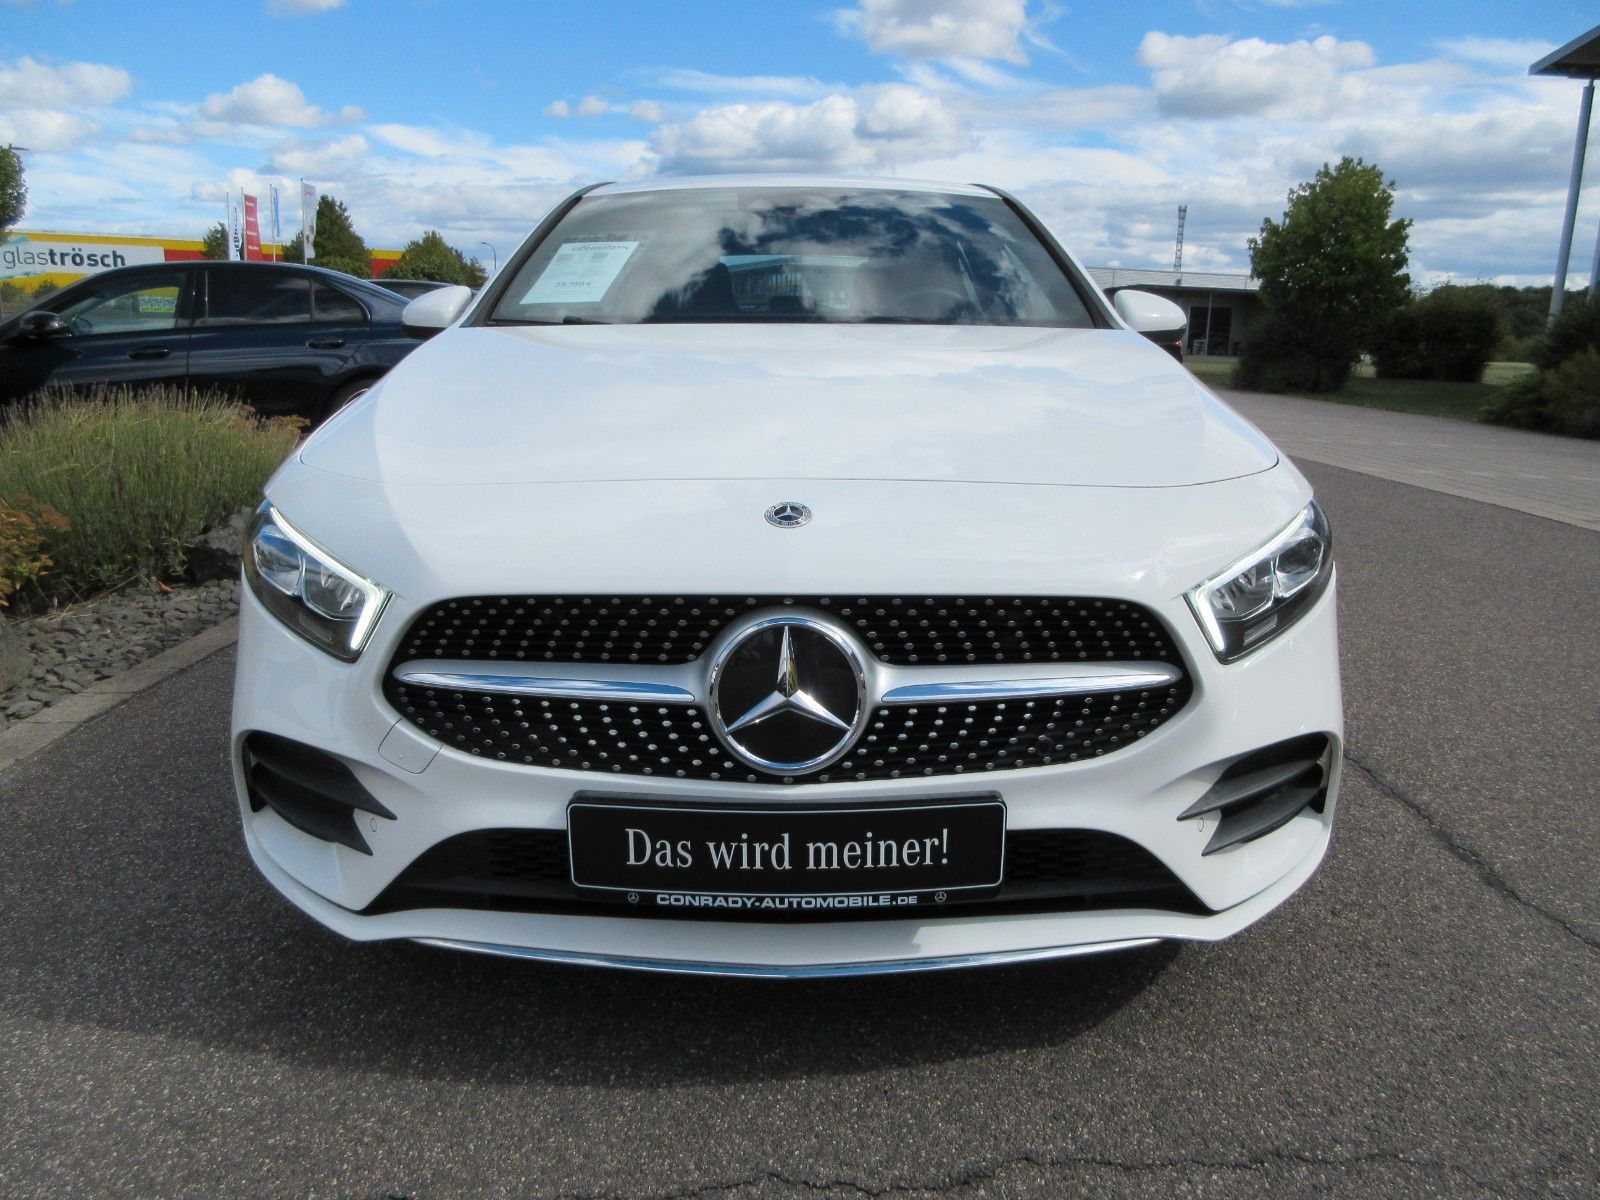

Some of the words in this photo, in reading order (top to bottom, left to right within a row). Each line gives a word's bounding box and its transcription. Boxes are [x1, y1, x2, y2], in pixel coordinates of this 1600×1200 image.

[3, 246, 126, 269] glaströsch
[625, 828, 693, 868] Das
[706, 832, 792, 870] wird
[806, 828, 949, 870] meiner!
[656, 894, 918, 908] CONRADY-AUTOMOBILE.DE
